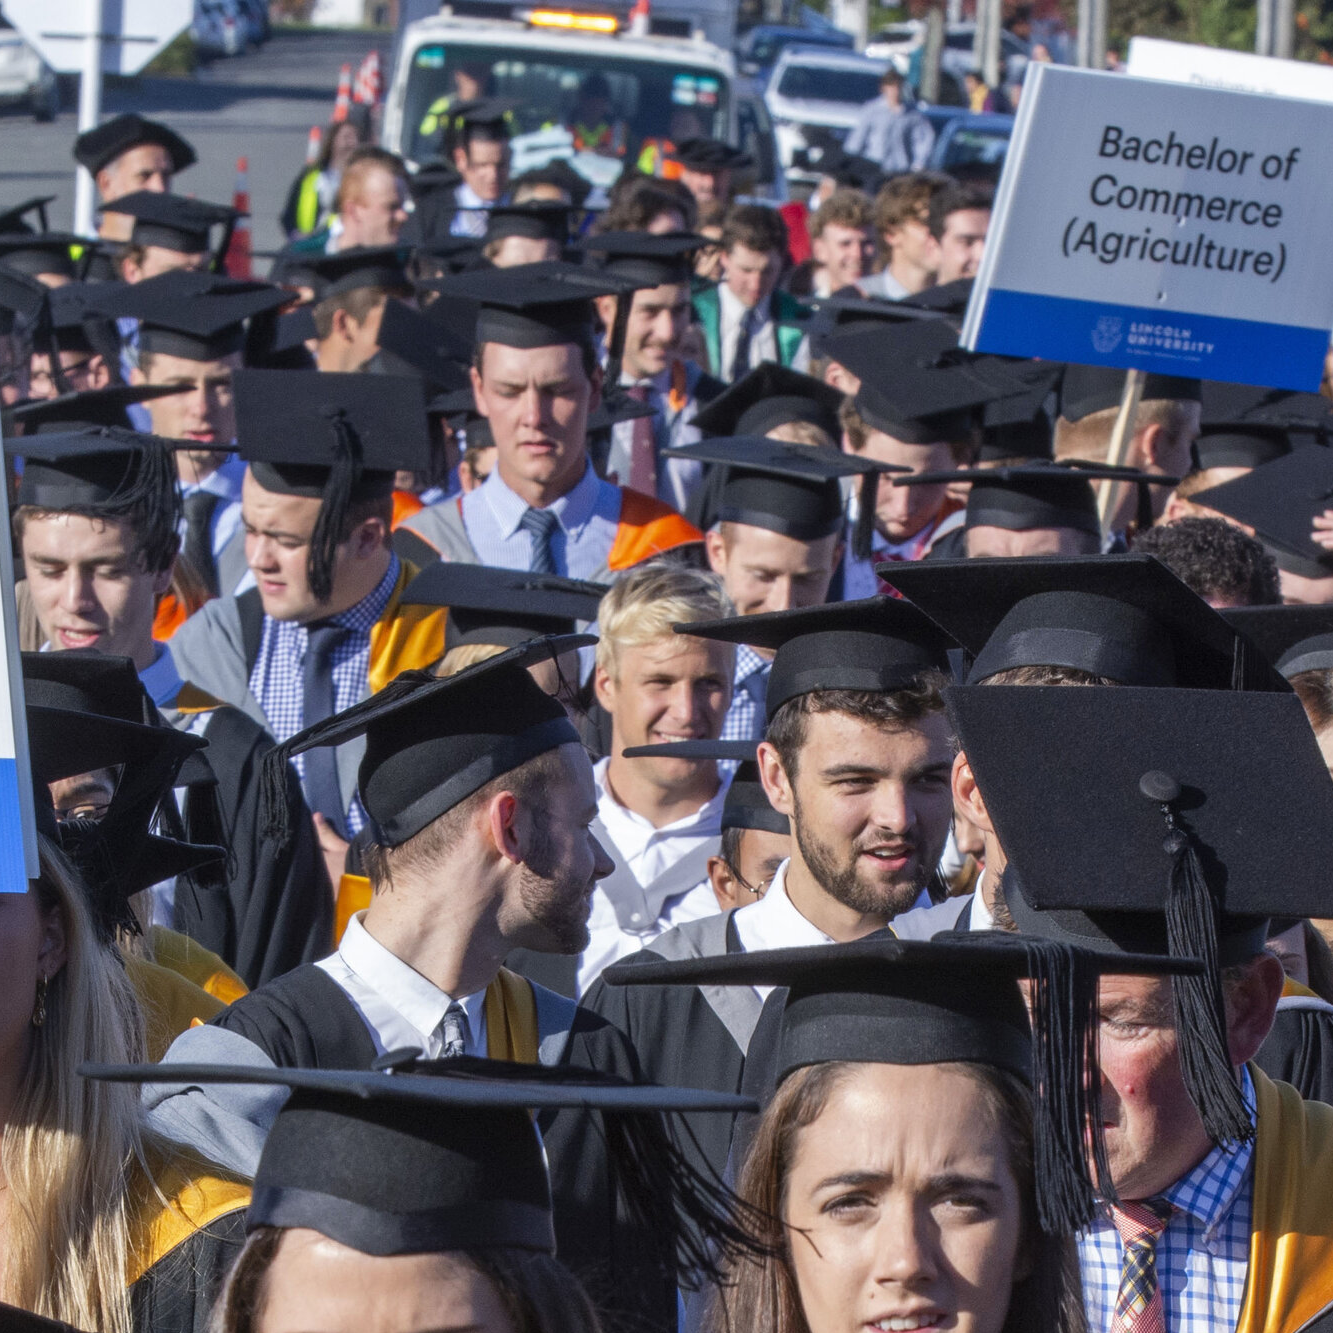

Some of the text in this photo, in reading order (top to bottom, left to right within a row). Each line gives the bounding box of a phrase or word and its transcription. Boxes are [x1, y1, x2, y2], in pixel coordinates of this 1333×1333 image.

[1098, 125, 1301, 181] Bachelor of
[1089, 174, 1283, 228] Commerce
[1062, 217, 1287, 283] (Agriculture)
[1128, 333, 1214, 353] UNIVERSITY
[1130, 322, 1192, 339] LINCOLN
